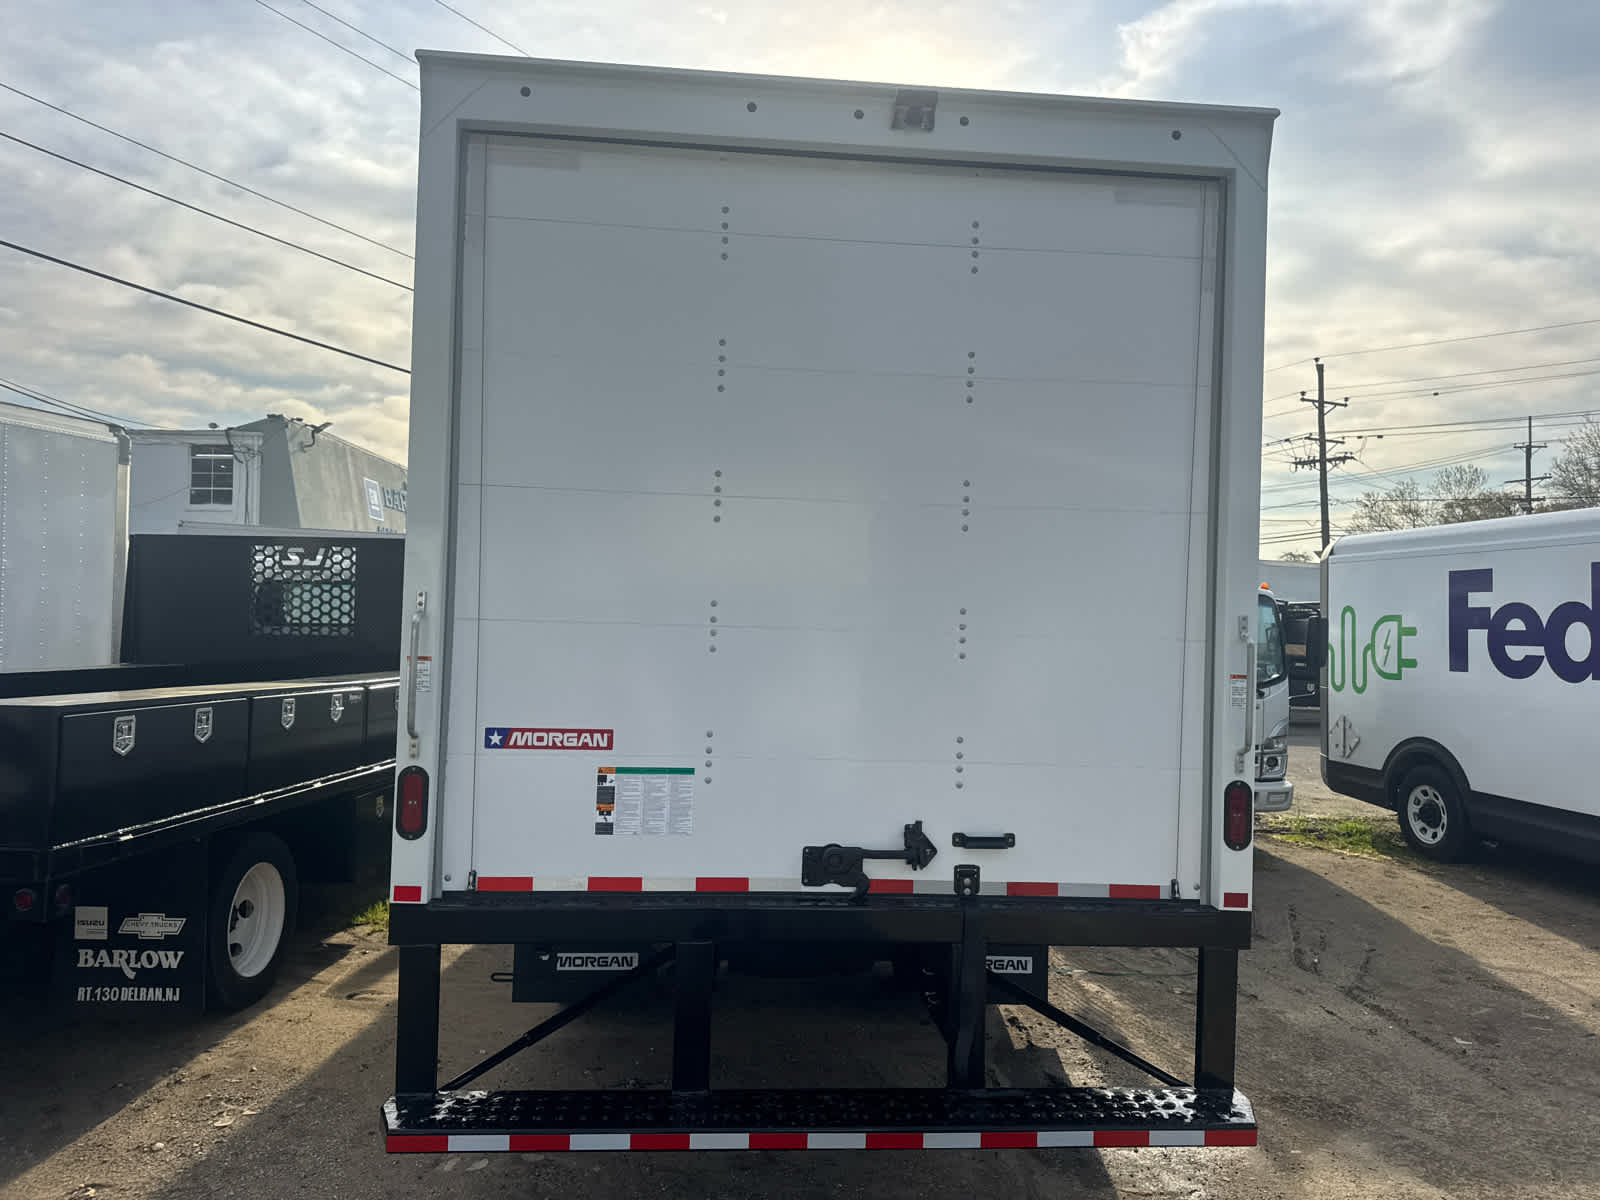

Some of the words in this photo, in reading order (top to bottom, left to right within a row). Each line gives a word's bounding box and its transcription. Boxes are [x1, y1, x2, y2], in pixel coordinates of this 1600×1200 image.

[1449, 561, 1600, 684] Fed
[508, 731, 609, 747] MORGAN
[126, 920, 150, 928] CHEVY
[151, 920, 178, 929] TRUCKS
[77, 949, 184, 980] BARLOW
[559, 955, 633, 968] MORGAN
